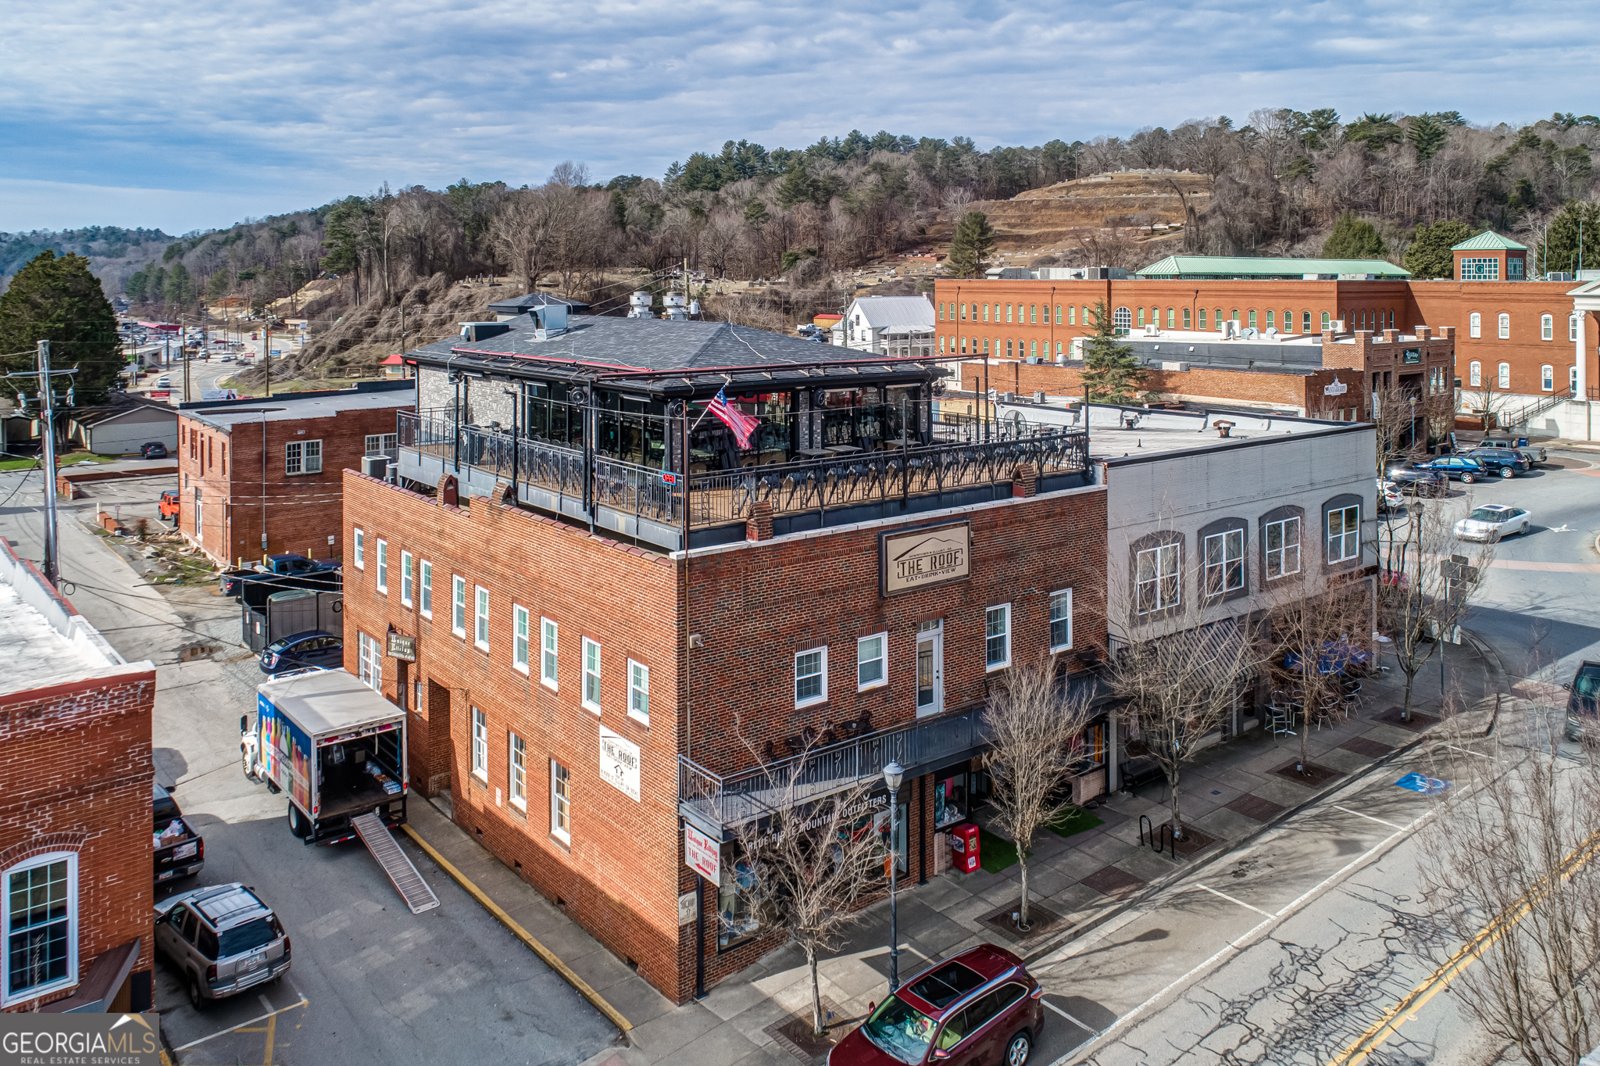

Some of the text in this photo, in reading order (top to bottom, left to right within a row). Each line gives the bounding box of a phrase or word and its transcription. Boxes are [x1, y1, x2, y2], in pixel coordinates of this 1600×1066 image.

[899, 558, 923, 577] THE
[930, 551, 960, 570] ROOF
[618, 750, 636, 767] ROOF
[688, 847, 699, 862] THE
[702, 857, 717, 873] ROOF
